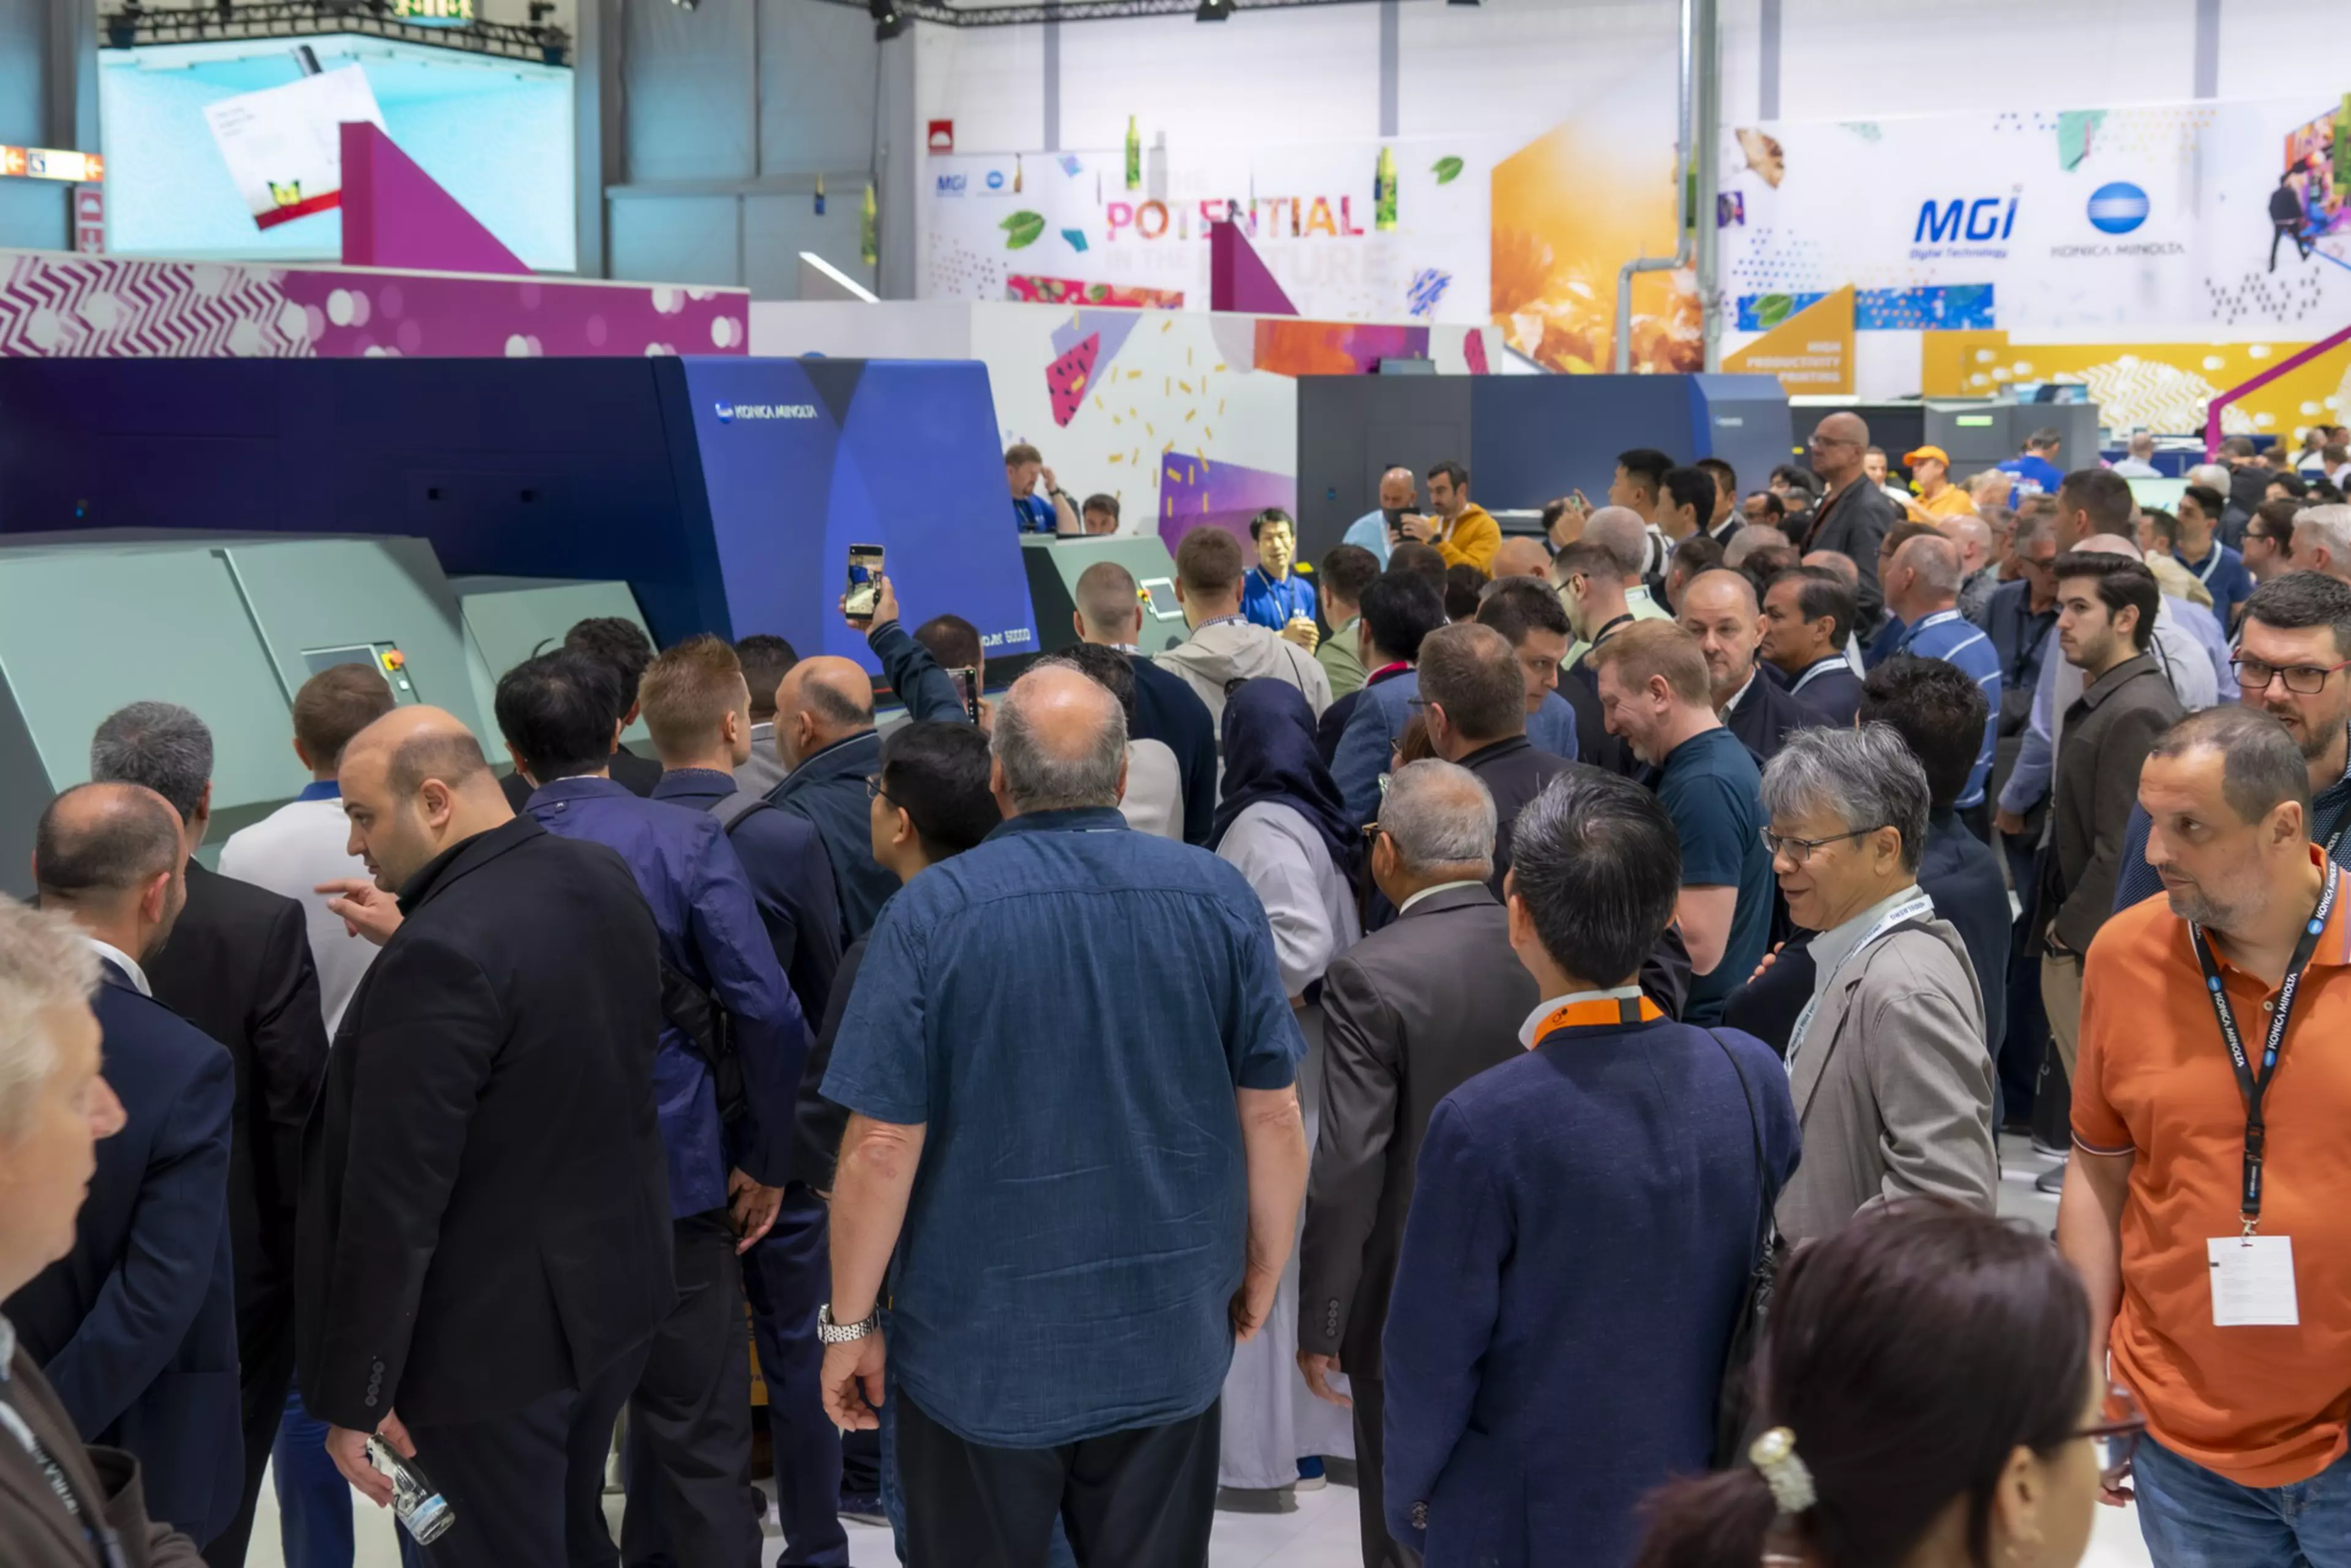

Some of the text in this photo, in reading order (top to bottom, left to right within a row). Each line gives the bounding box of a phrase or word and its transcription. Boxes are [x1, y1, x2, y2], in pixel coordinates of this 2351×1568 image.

[735, 404, 819, 419] KONICA MINOLTA
[2315, 889, 2334, 919] KONICA
[2214, 991, 2245, 1067] KONICA MINOLTA
[2268, 973, 2298, 1049] KONICA MINOLTA
